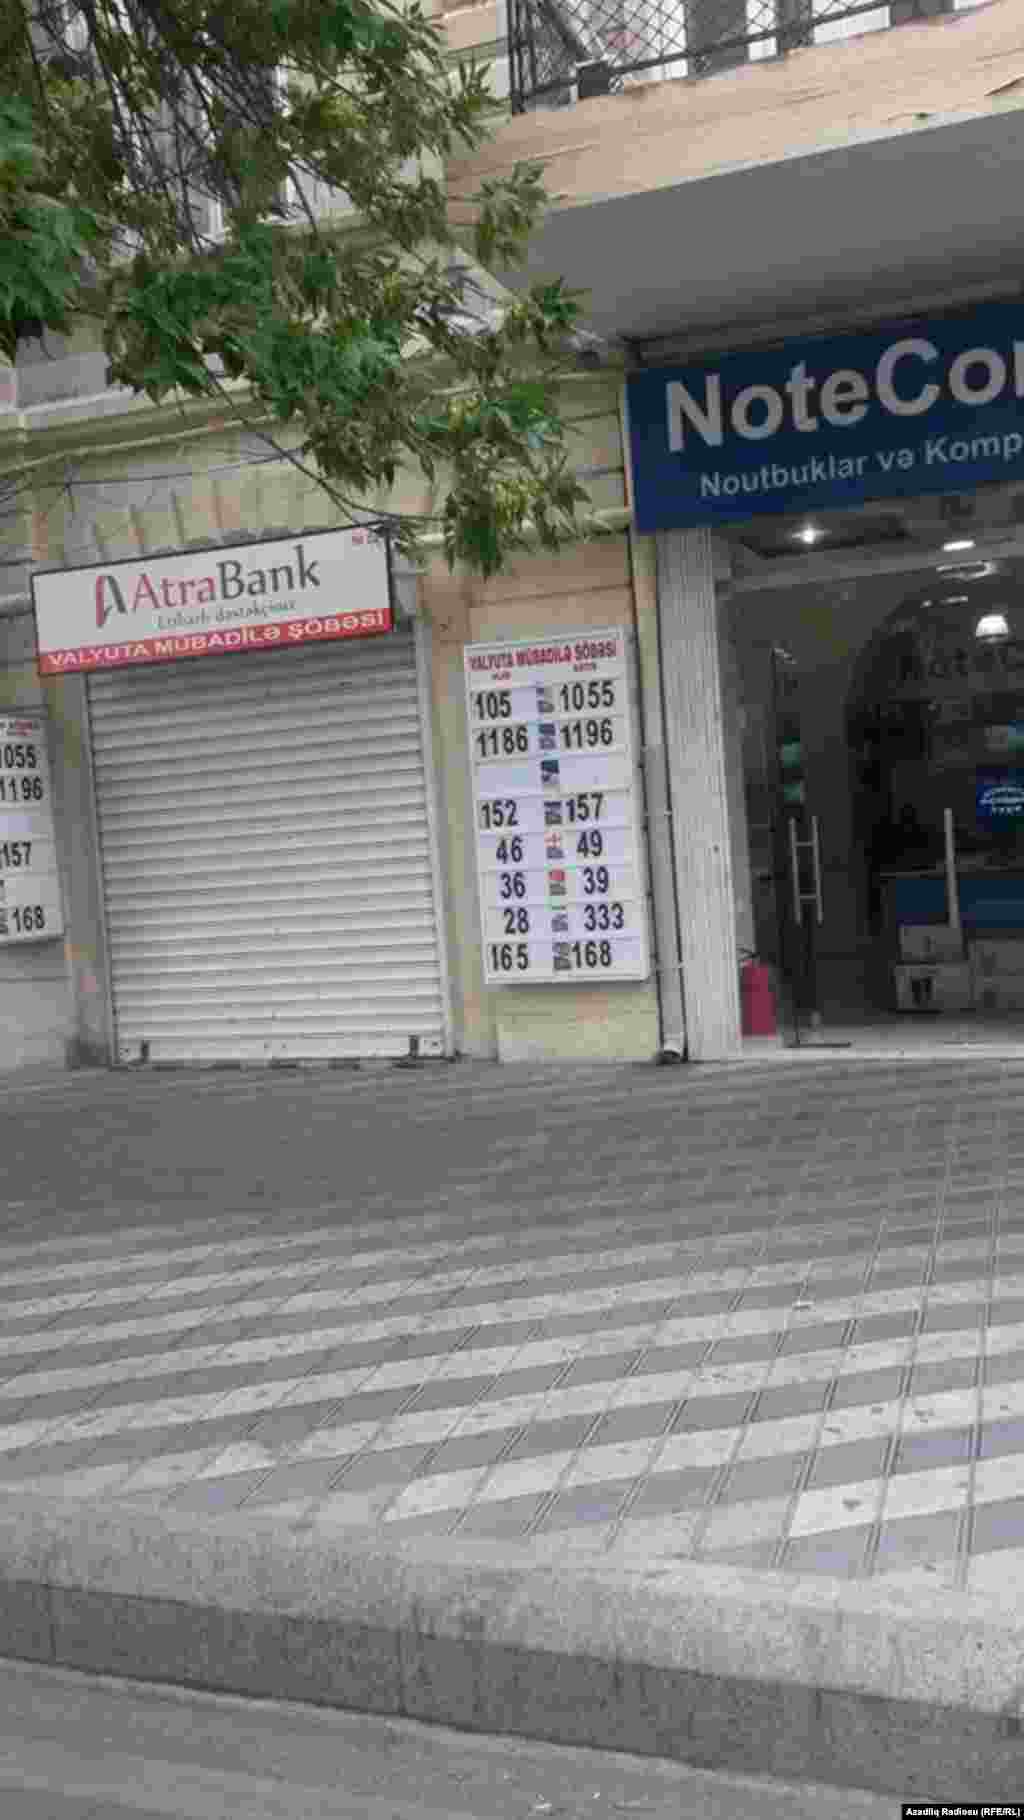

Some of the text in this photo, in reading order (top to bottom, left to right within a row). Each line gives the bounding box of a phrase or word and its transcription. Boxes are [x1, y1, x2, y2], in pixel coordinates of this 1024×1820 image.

[700, 430, 1023, 498] Noutbuklar və Komp
[131, 544, 321, 612] AtraBank
[47, 644, 149, 667] VALYUTA
[474, 681, 614, 720] 105 1055
[475, 725, 528, 757] 1186
[560, 718, 613, 749] 1196
[0, 744, 37, 769] 055
[481, 793, 604, 829] 152 157
[3, 841, 32, 867] 157
[496, 830, 603, 864] 46 49
[500, 866, 609, 899] 36 39
[12, 905, 45, 932] 168
[504, 903, 624, 935] 28 333
[490, 939, 612, 971] 165 168
